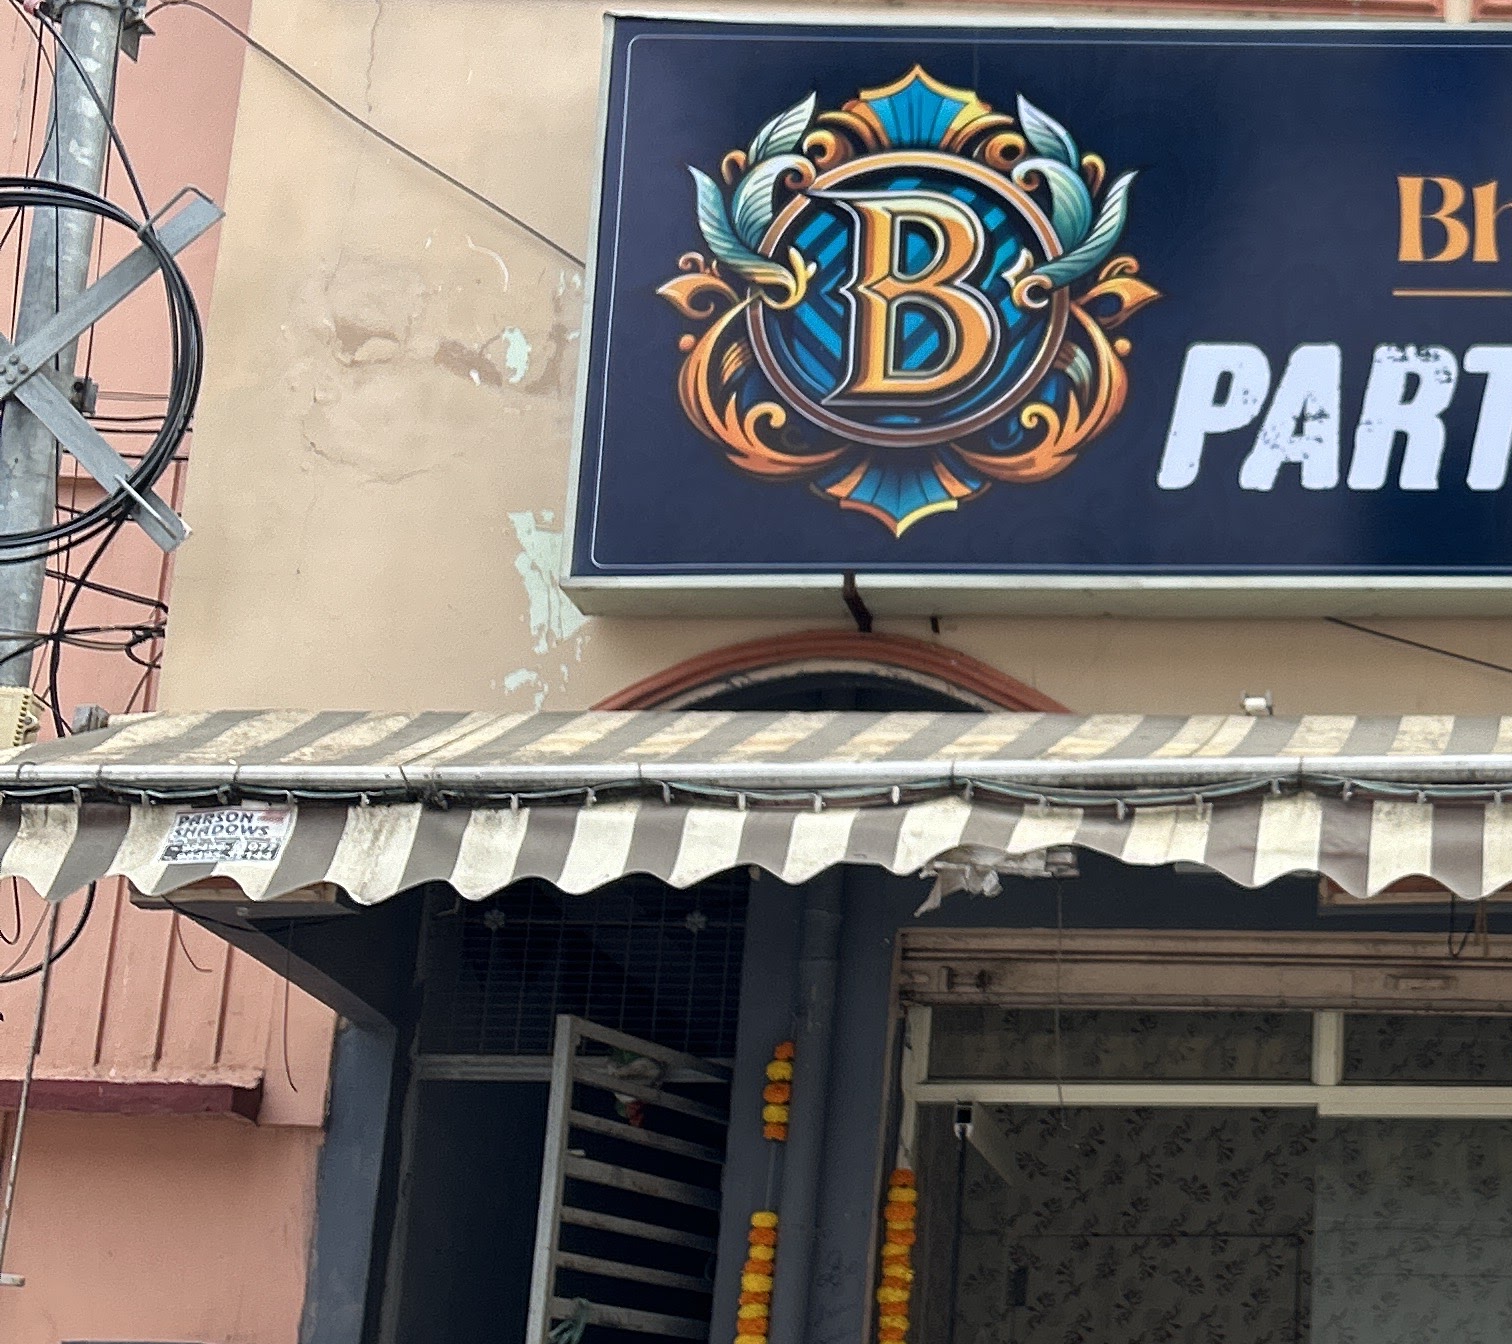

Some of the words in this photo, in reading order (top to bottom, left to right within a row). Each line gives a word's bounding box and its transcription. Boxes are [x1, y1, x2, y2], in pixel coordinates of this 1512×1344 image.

[806, 188, 1002, 407] B
[178, 811, 254, 825] PARSON
[174, 824, 270, 837] SHADOWS
